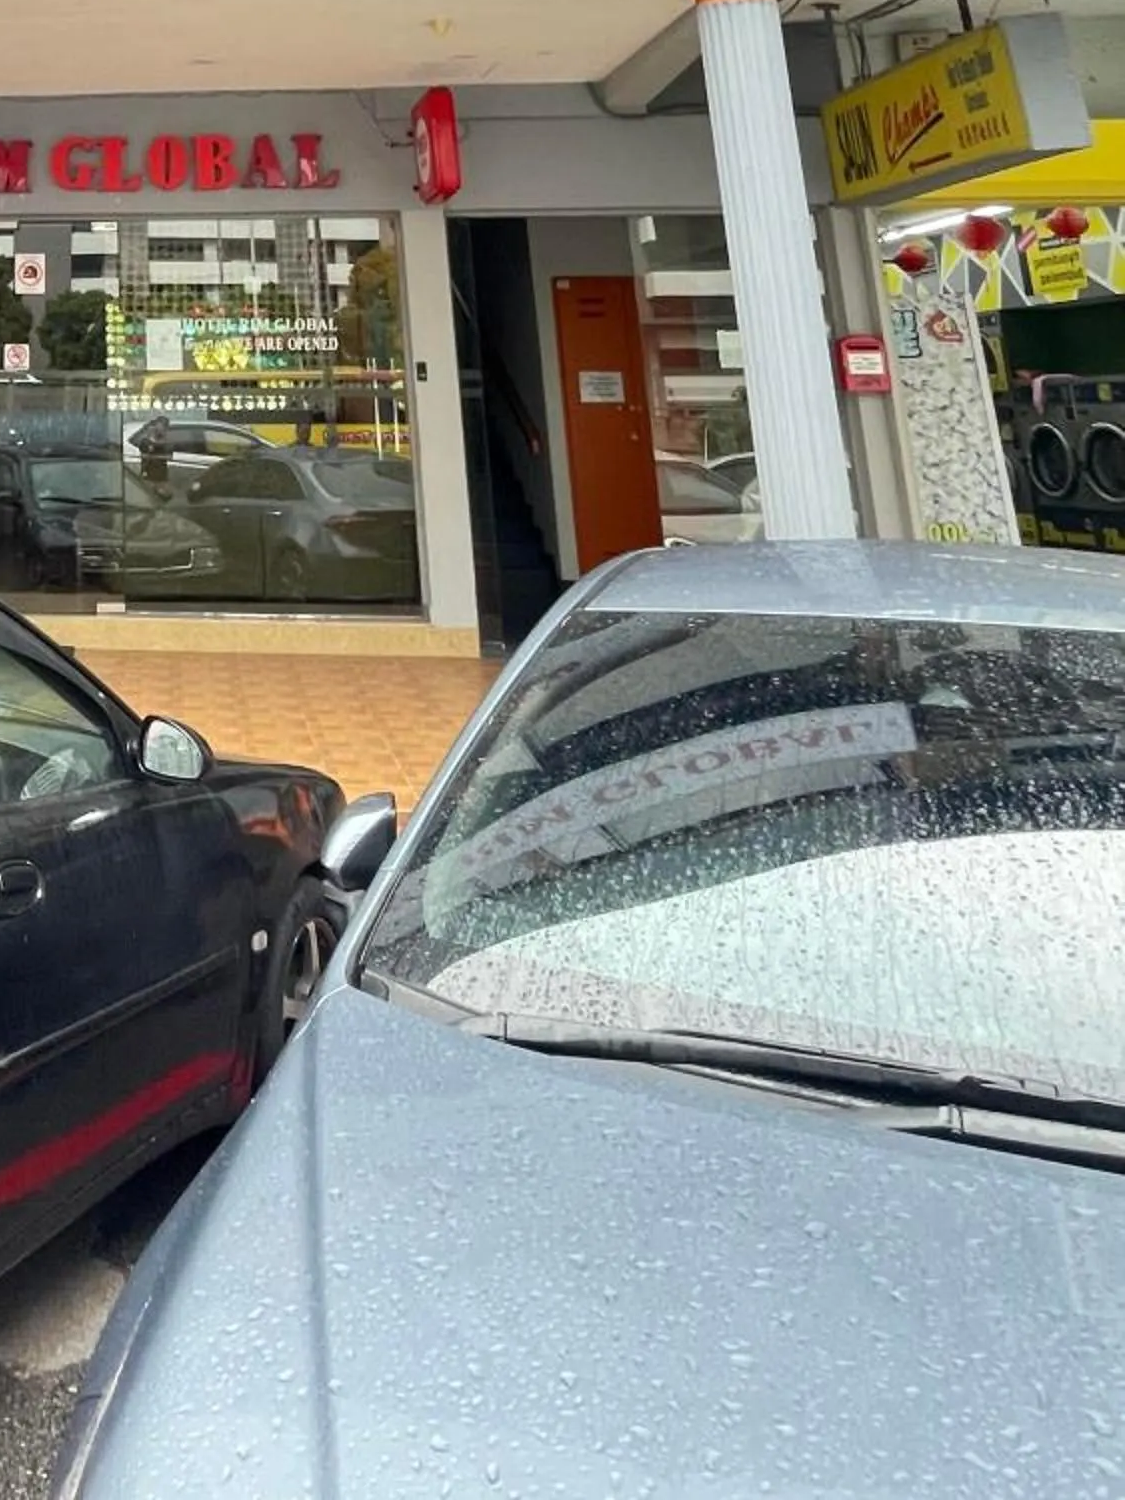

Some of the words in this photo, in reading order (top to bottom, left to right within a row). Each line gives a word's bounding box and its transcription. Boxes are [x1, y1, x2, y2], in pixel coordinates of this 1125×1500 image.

[49, 132, 340, 193] GLOBAL
[273, 317, 338, 332] GLOBAL
[287, 336, 339, 351] OPENED
